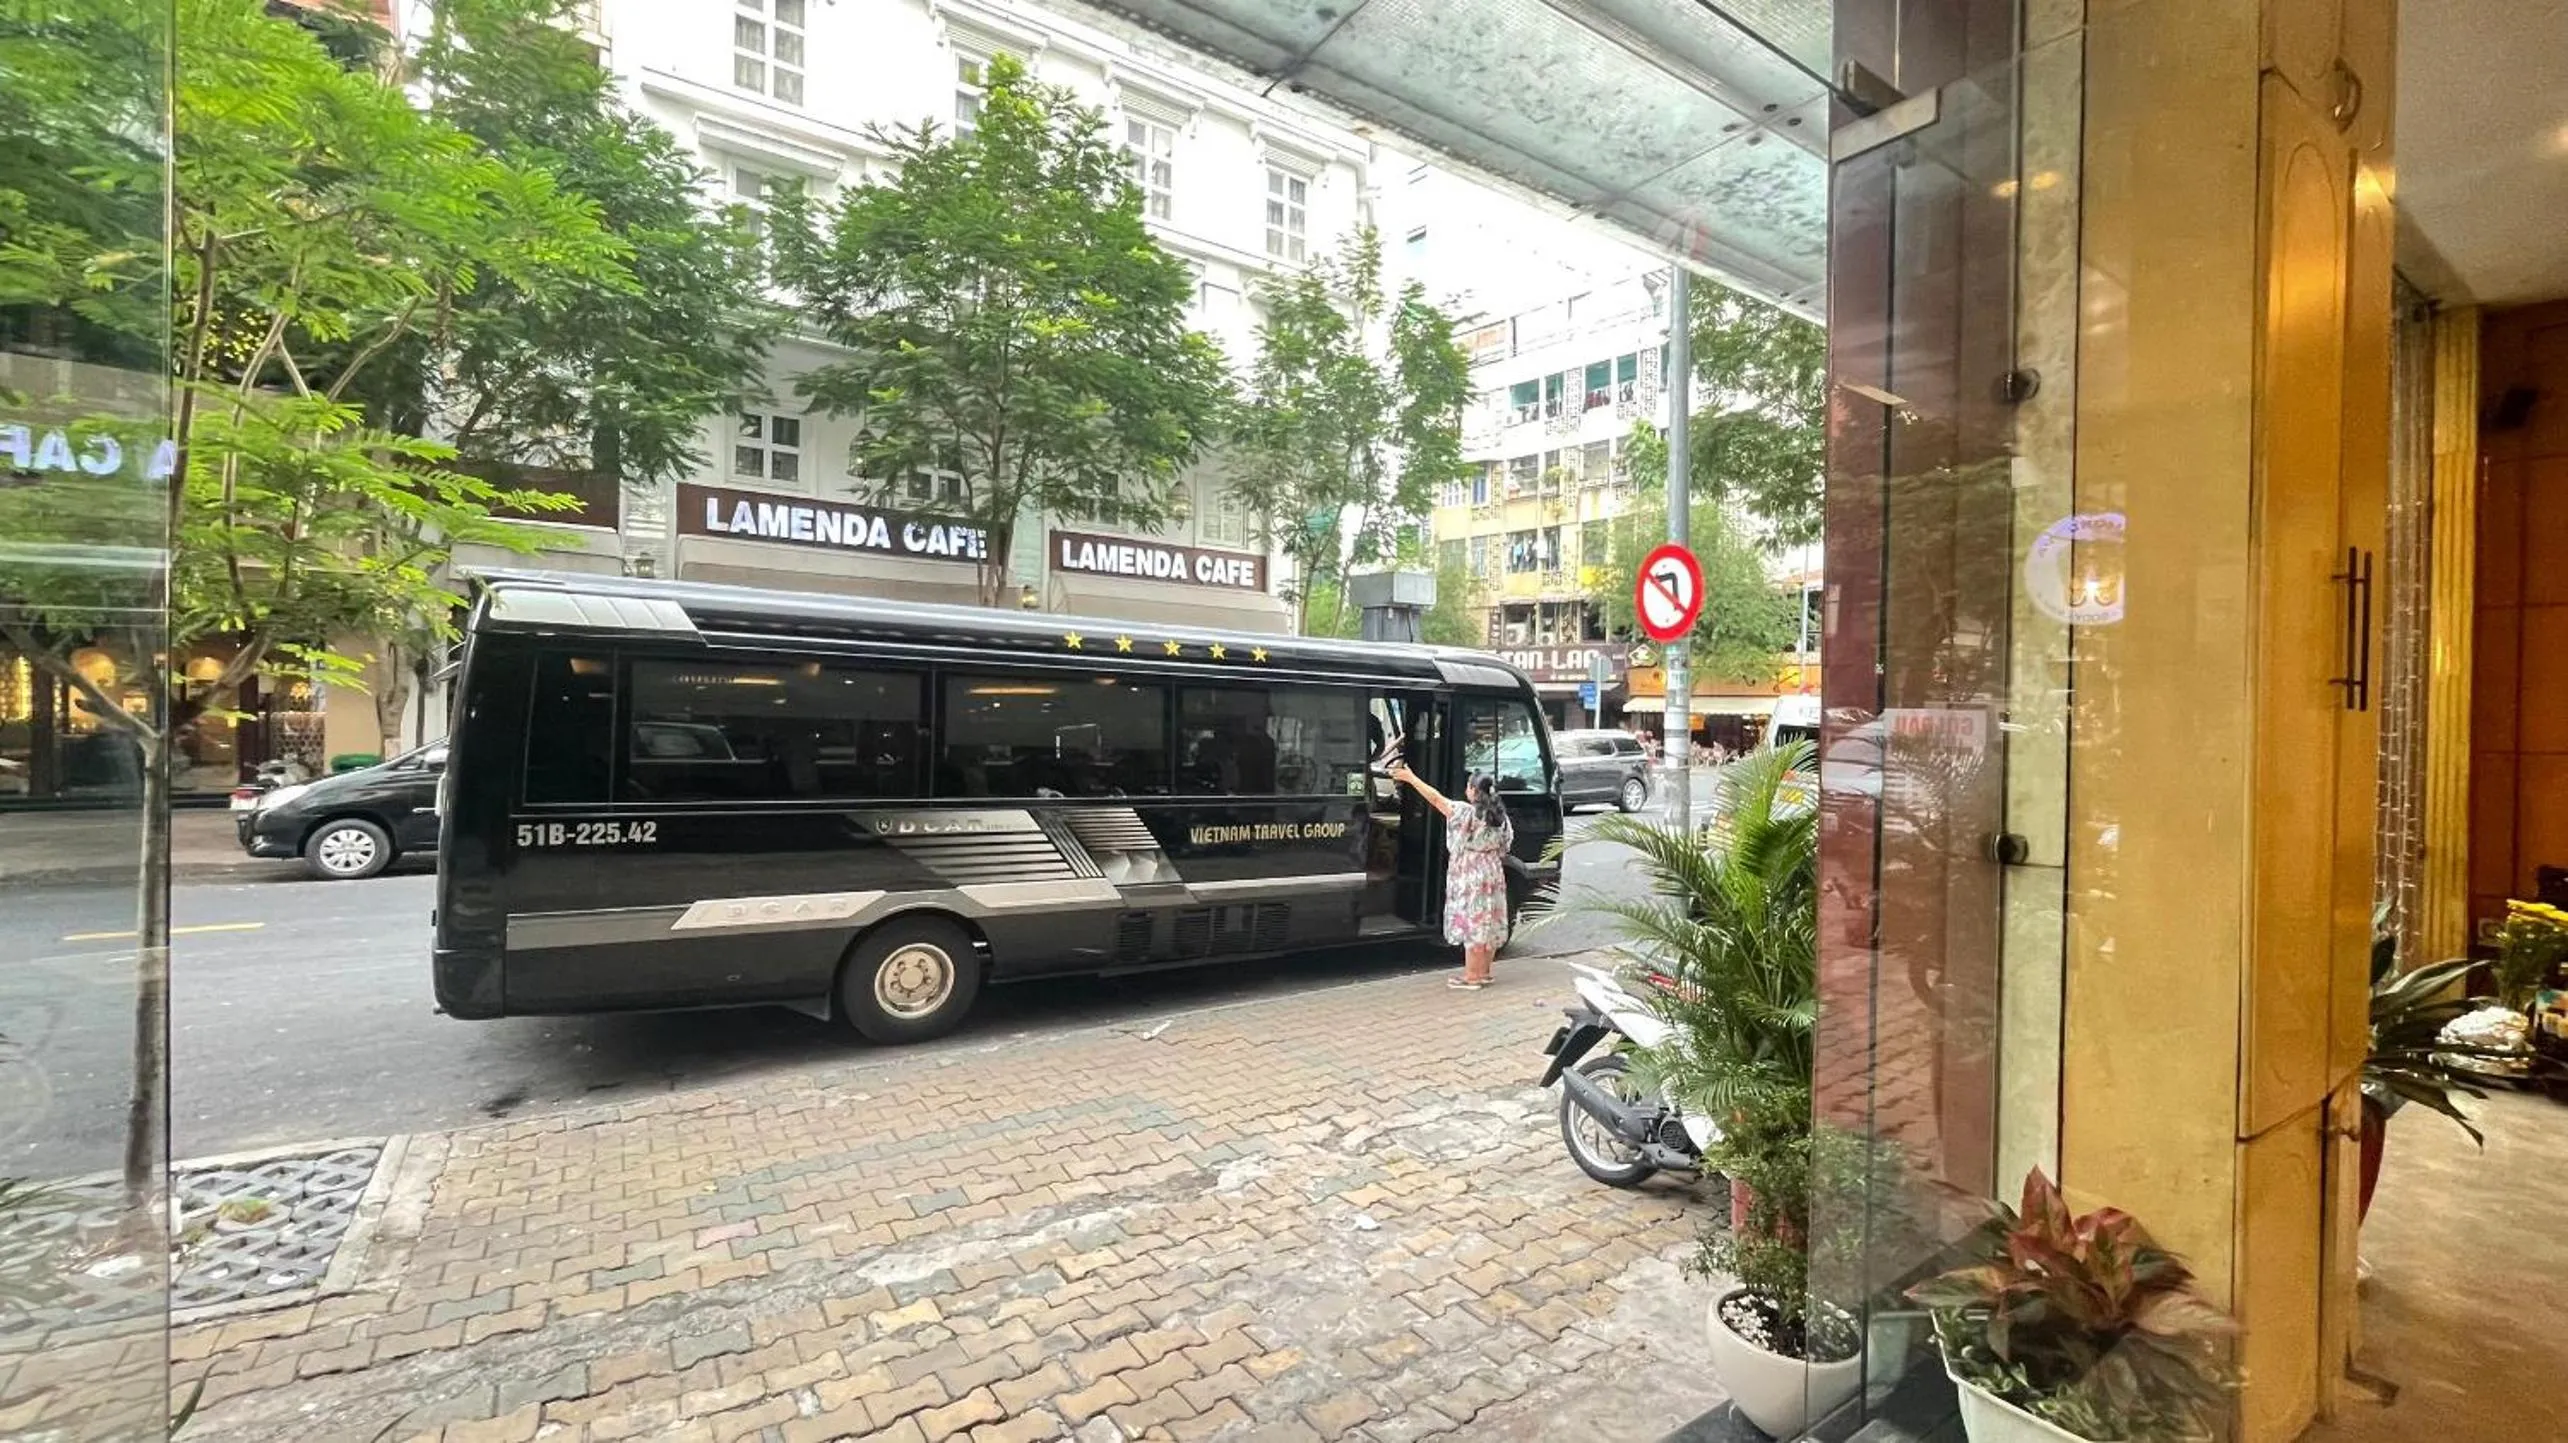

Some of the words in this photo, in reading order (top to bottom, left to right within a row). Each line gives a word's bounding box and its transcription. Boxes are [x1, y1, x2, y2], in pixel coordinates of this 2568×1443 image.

[706, 497, 892, 549] LAMENDA
[902, 521, 988, 560] CAFE
[1062, 539, 1189, 580] LAMENDA
[1194, 555, 1256, 587] CAFE
[516, 821, 658, 847] 51B-225.42
[1190, 824, 1251, 845] VIETNAM
[1254, 823, 1301, 841] TRAVEL
[1303, 822, 1346, 839] GROUP
